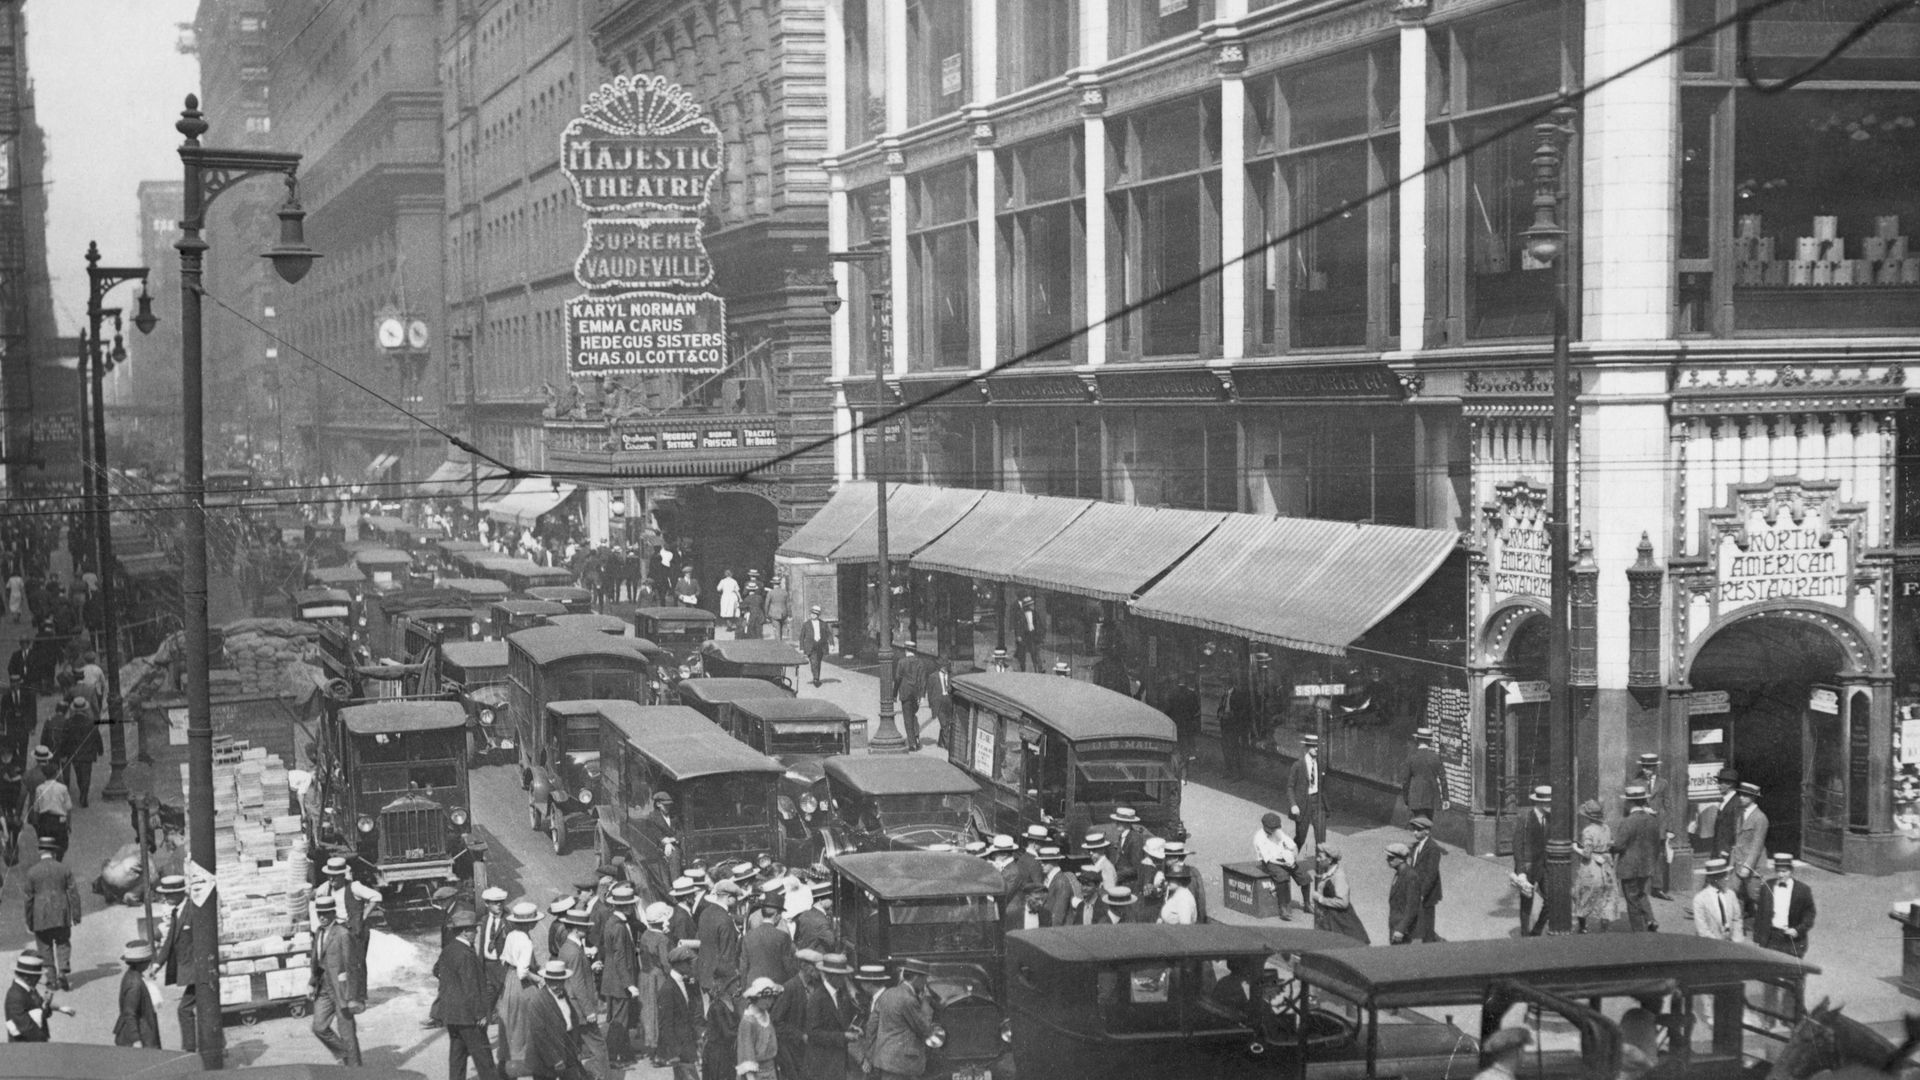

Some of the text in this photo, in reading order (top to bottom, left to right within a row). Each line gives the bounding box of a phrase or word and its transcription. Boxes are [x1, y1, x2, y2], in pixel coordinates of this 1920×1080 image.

[569, 141, 719, 170] MAJESTIC
[580, 174, 706, 198] THEATRE
[595, 232, 695, 250] SUPREME
[584, 256, 706, 278] VAUDEVILLE
[573, 302, 696, 318] KARYL NORMAN
[578, 318, 683, 334] EMMA CARUS
[580, 333, 722, 350] HEDEGUS SISTERS
[702, 437, 738, 448] FRISCOE
[1748, 529, 1818, 552] NORTH
[1730, 552, 1836, 577] AMERICAN
[1720, 575, 1847, 602] RESTAURANT
[1303, 684, 1332, 697] STATE
[1333, 683, 1346, 696] ST
